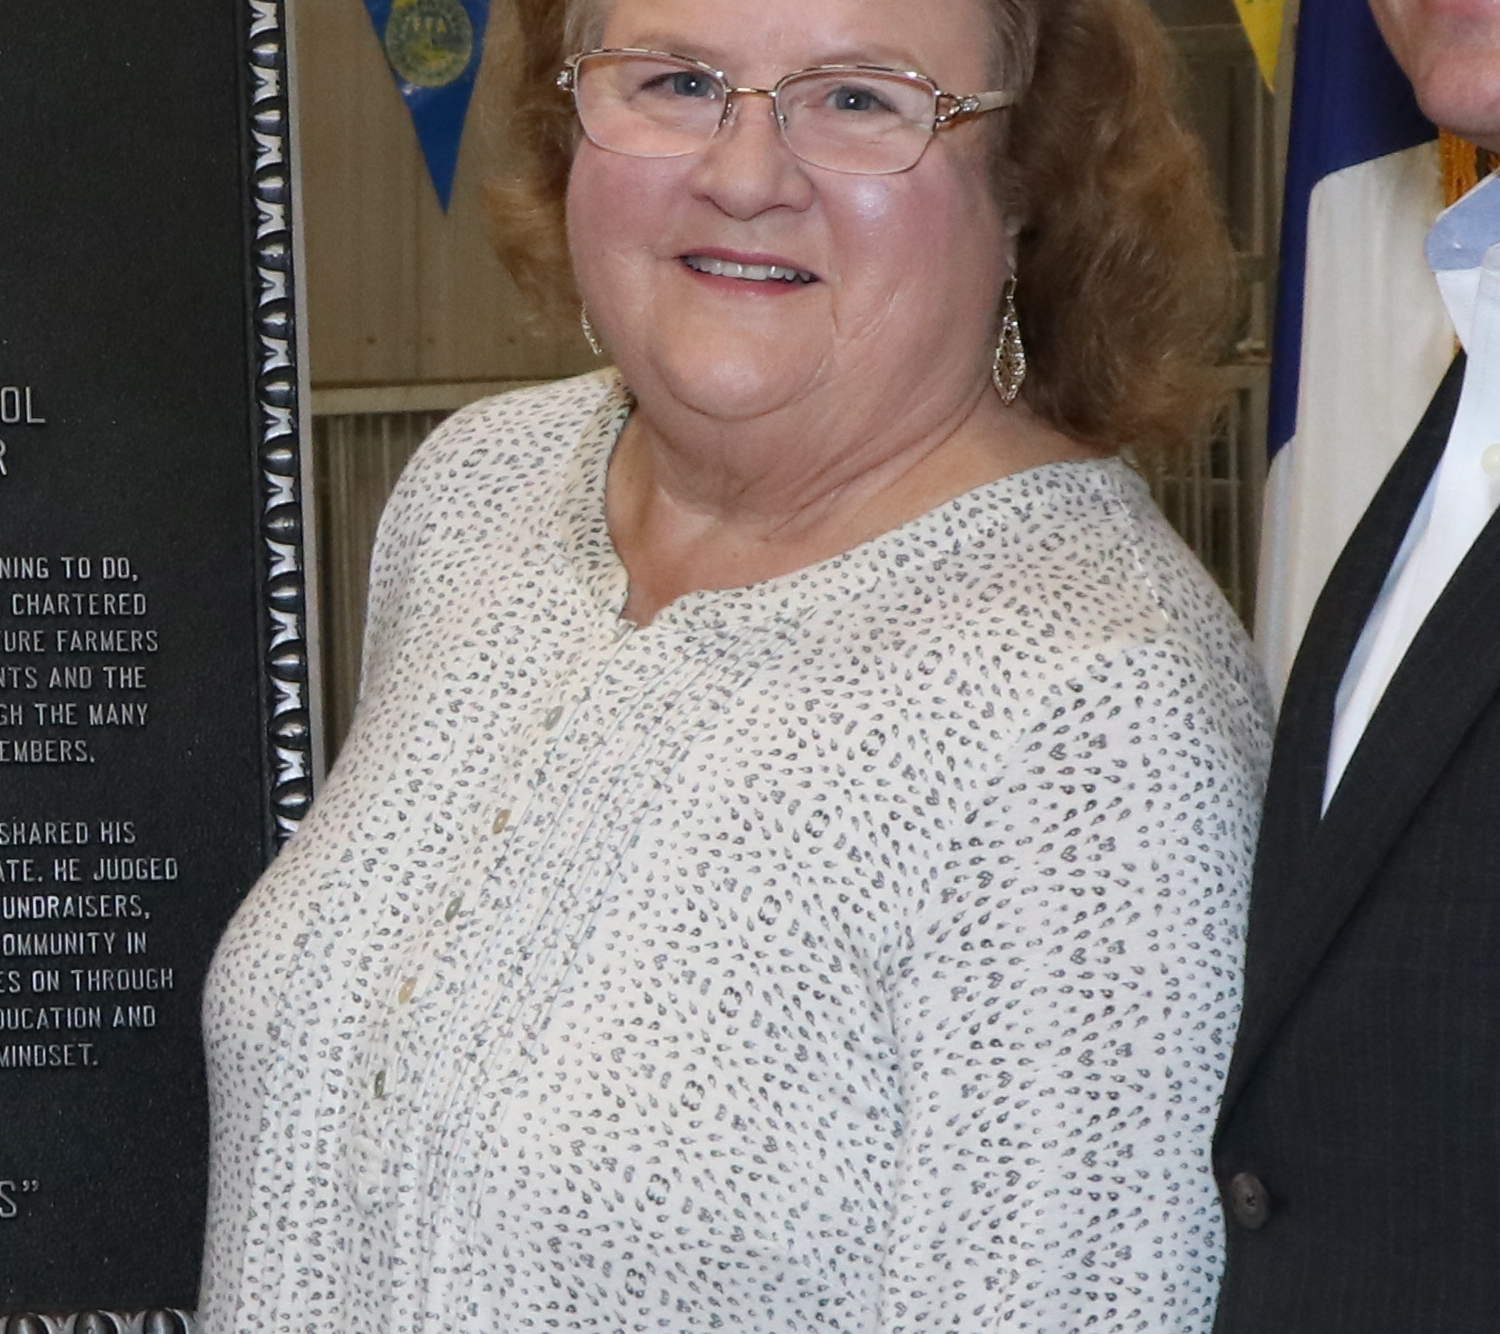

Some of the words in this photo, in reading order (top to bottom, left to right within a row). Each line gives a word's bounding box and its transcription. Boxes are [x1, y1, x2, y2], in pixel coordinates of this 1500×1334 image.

[60, 555, 91, 578] TO
[102, 555, 139, 581] DO,
[12, 592, 147, 616] CHARTERED
[56, 629, 159, 652] FARMERS
[48, 665, 92, 689] AND
[102, 665, 147, 689] THE
[33, 702, 78, 725] THE
[88, 702, 148, 726] MANY
[100, 820, 136, 844] HIS
[54, 857, 82, 882] HE
[92, 856, 178, 880] JUDGED
[127, 930, 147, 954] IN
[31, 969, 60, 993] ON
[70, 967, 174, 992] THROUGH
[112, 1004, 156, 1027] AND
